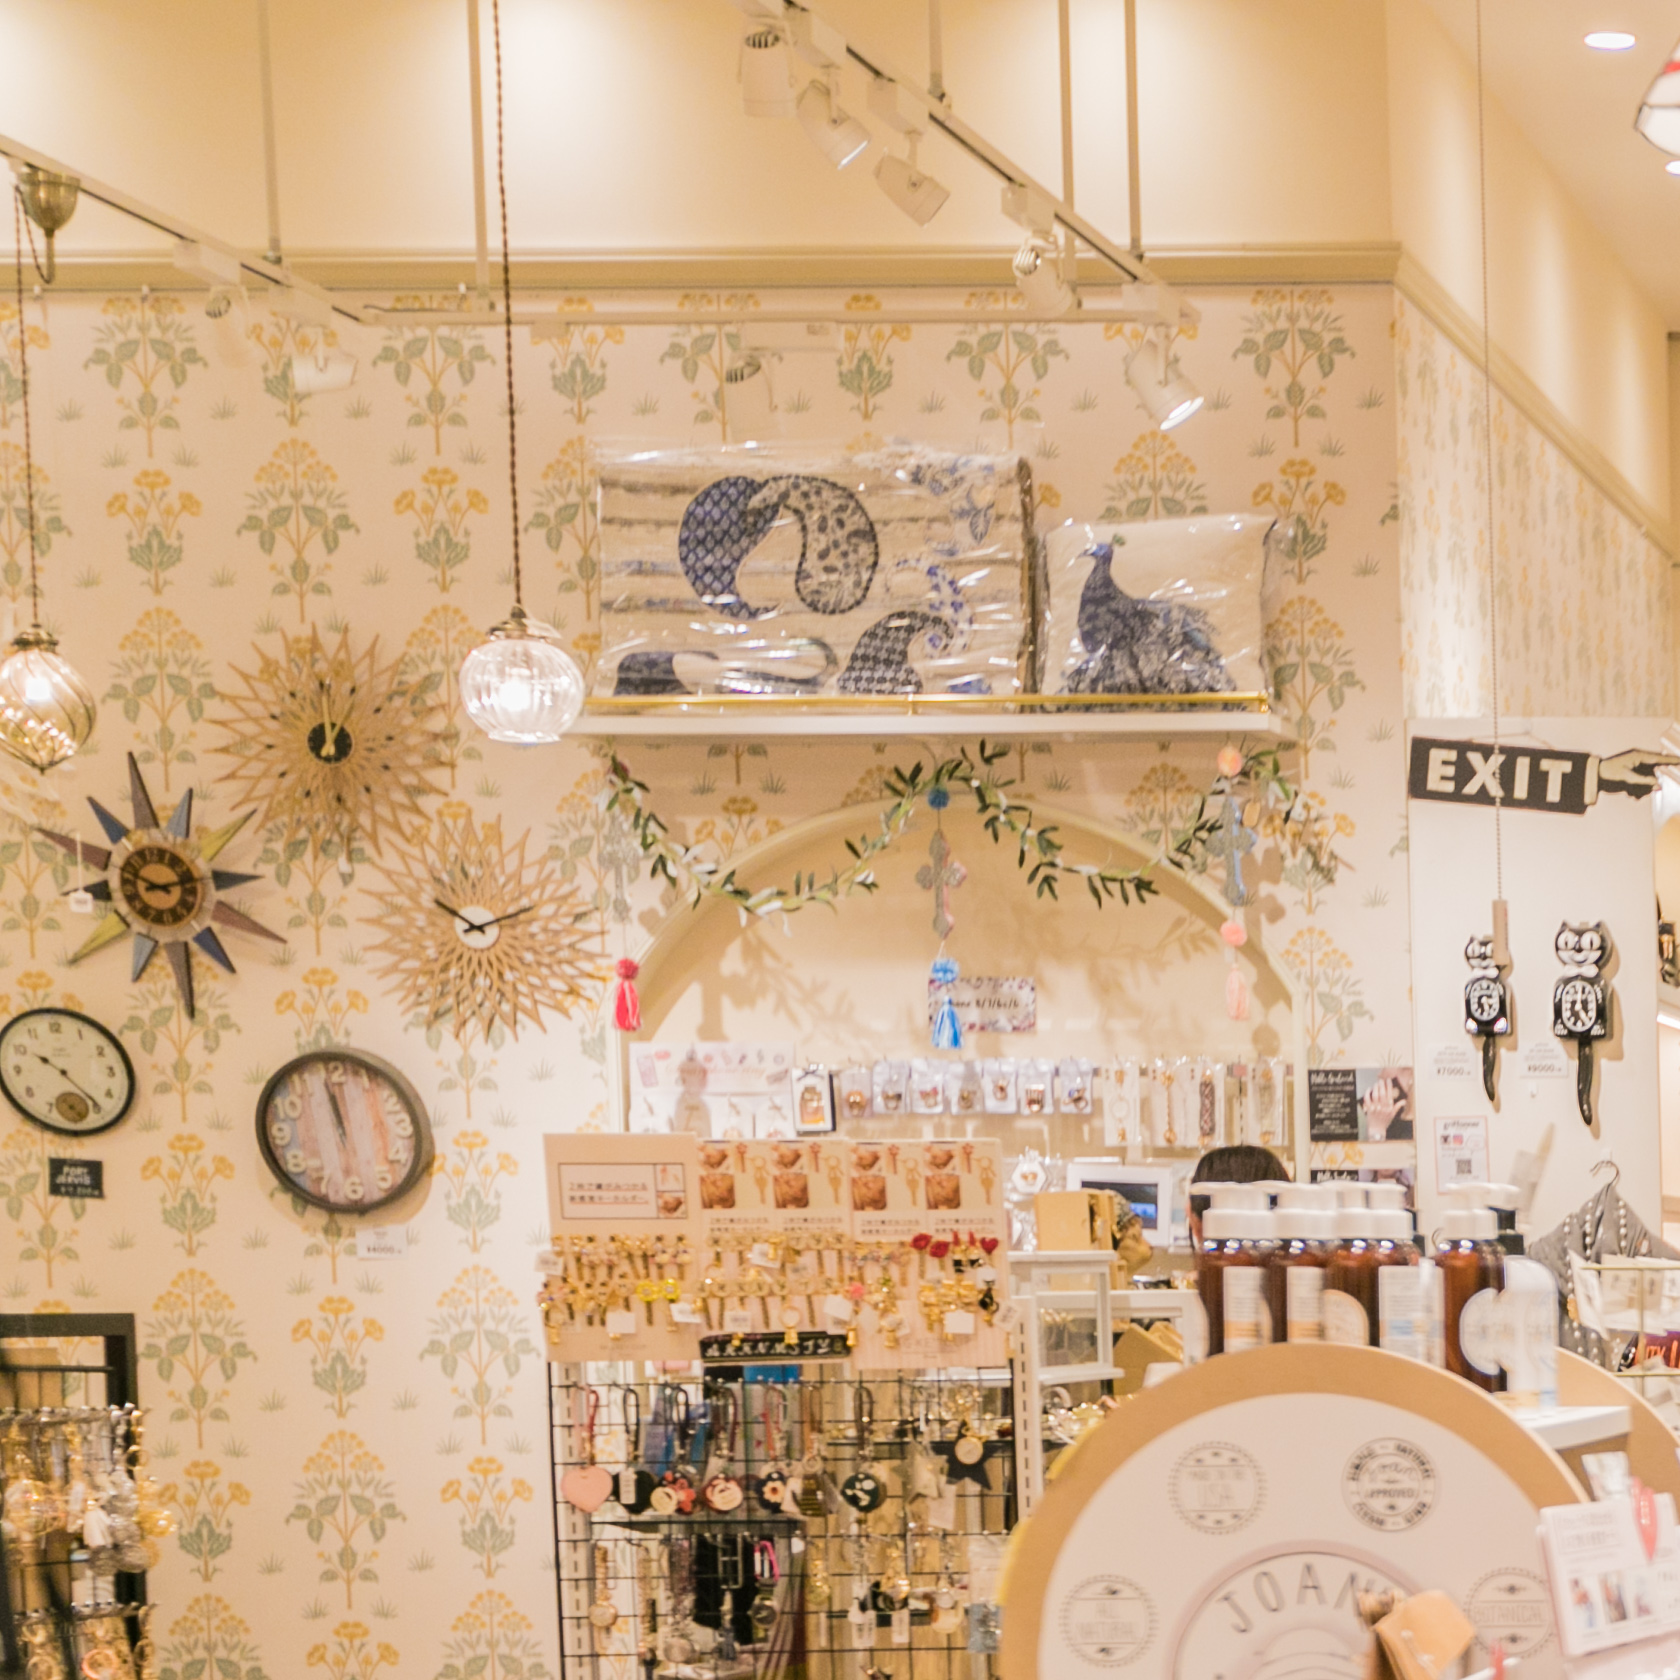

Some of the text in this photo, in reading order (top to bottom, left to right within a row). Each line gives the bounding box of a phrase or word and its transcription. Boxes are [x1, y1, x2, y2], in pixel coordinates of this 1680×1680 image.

[1426, 747, 1573, 804] EXIT
[48, 1022, 62, 1034] 12
[77, 1029, 84, 1041] 1
[13, 1044, 28, 1055] 10
[96, 1045, 105, 1058] 2
[106, 1066, 117, 1078] 3
[361, 1067, 370, 1088] 1
[104, 1088, 114, 1099] 4
[46, 1102, 54, 1114] 7
[273, 1094, 303, 1120] 10
[271, 1122, 292, 1147] 9
[394, 1113, 414, 1138] 3
[286, 1148, 306, 1174] 8
[388, 1146, 409, 1165] 4
[344, 1176, 365, 1200] 6
[375, 1165, 393, 1190] 5
[1473, 1603, 1546, 1624] BOTANICAL
